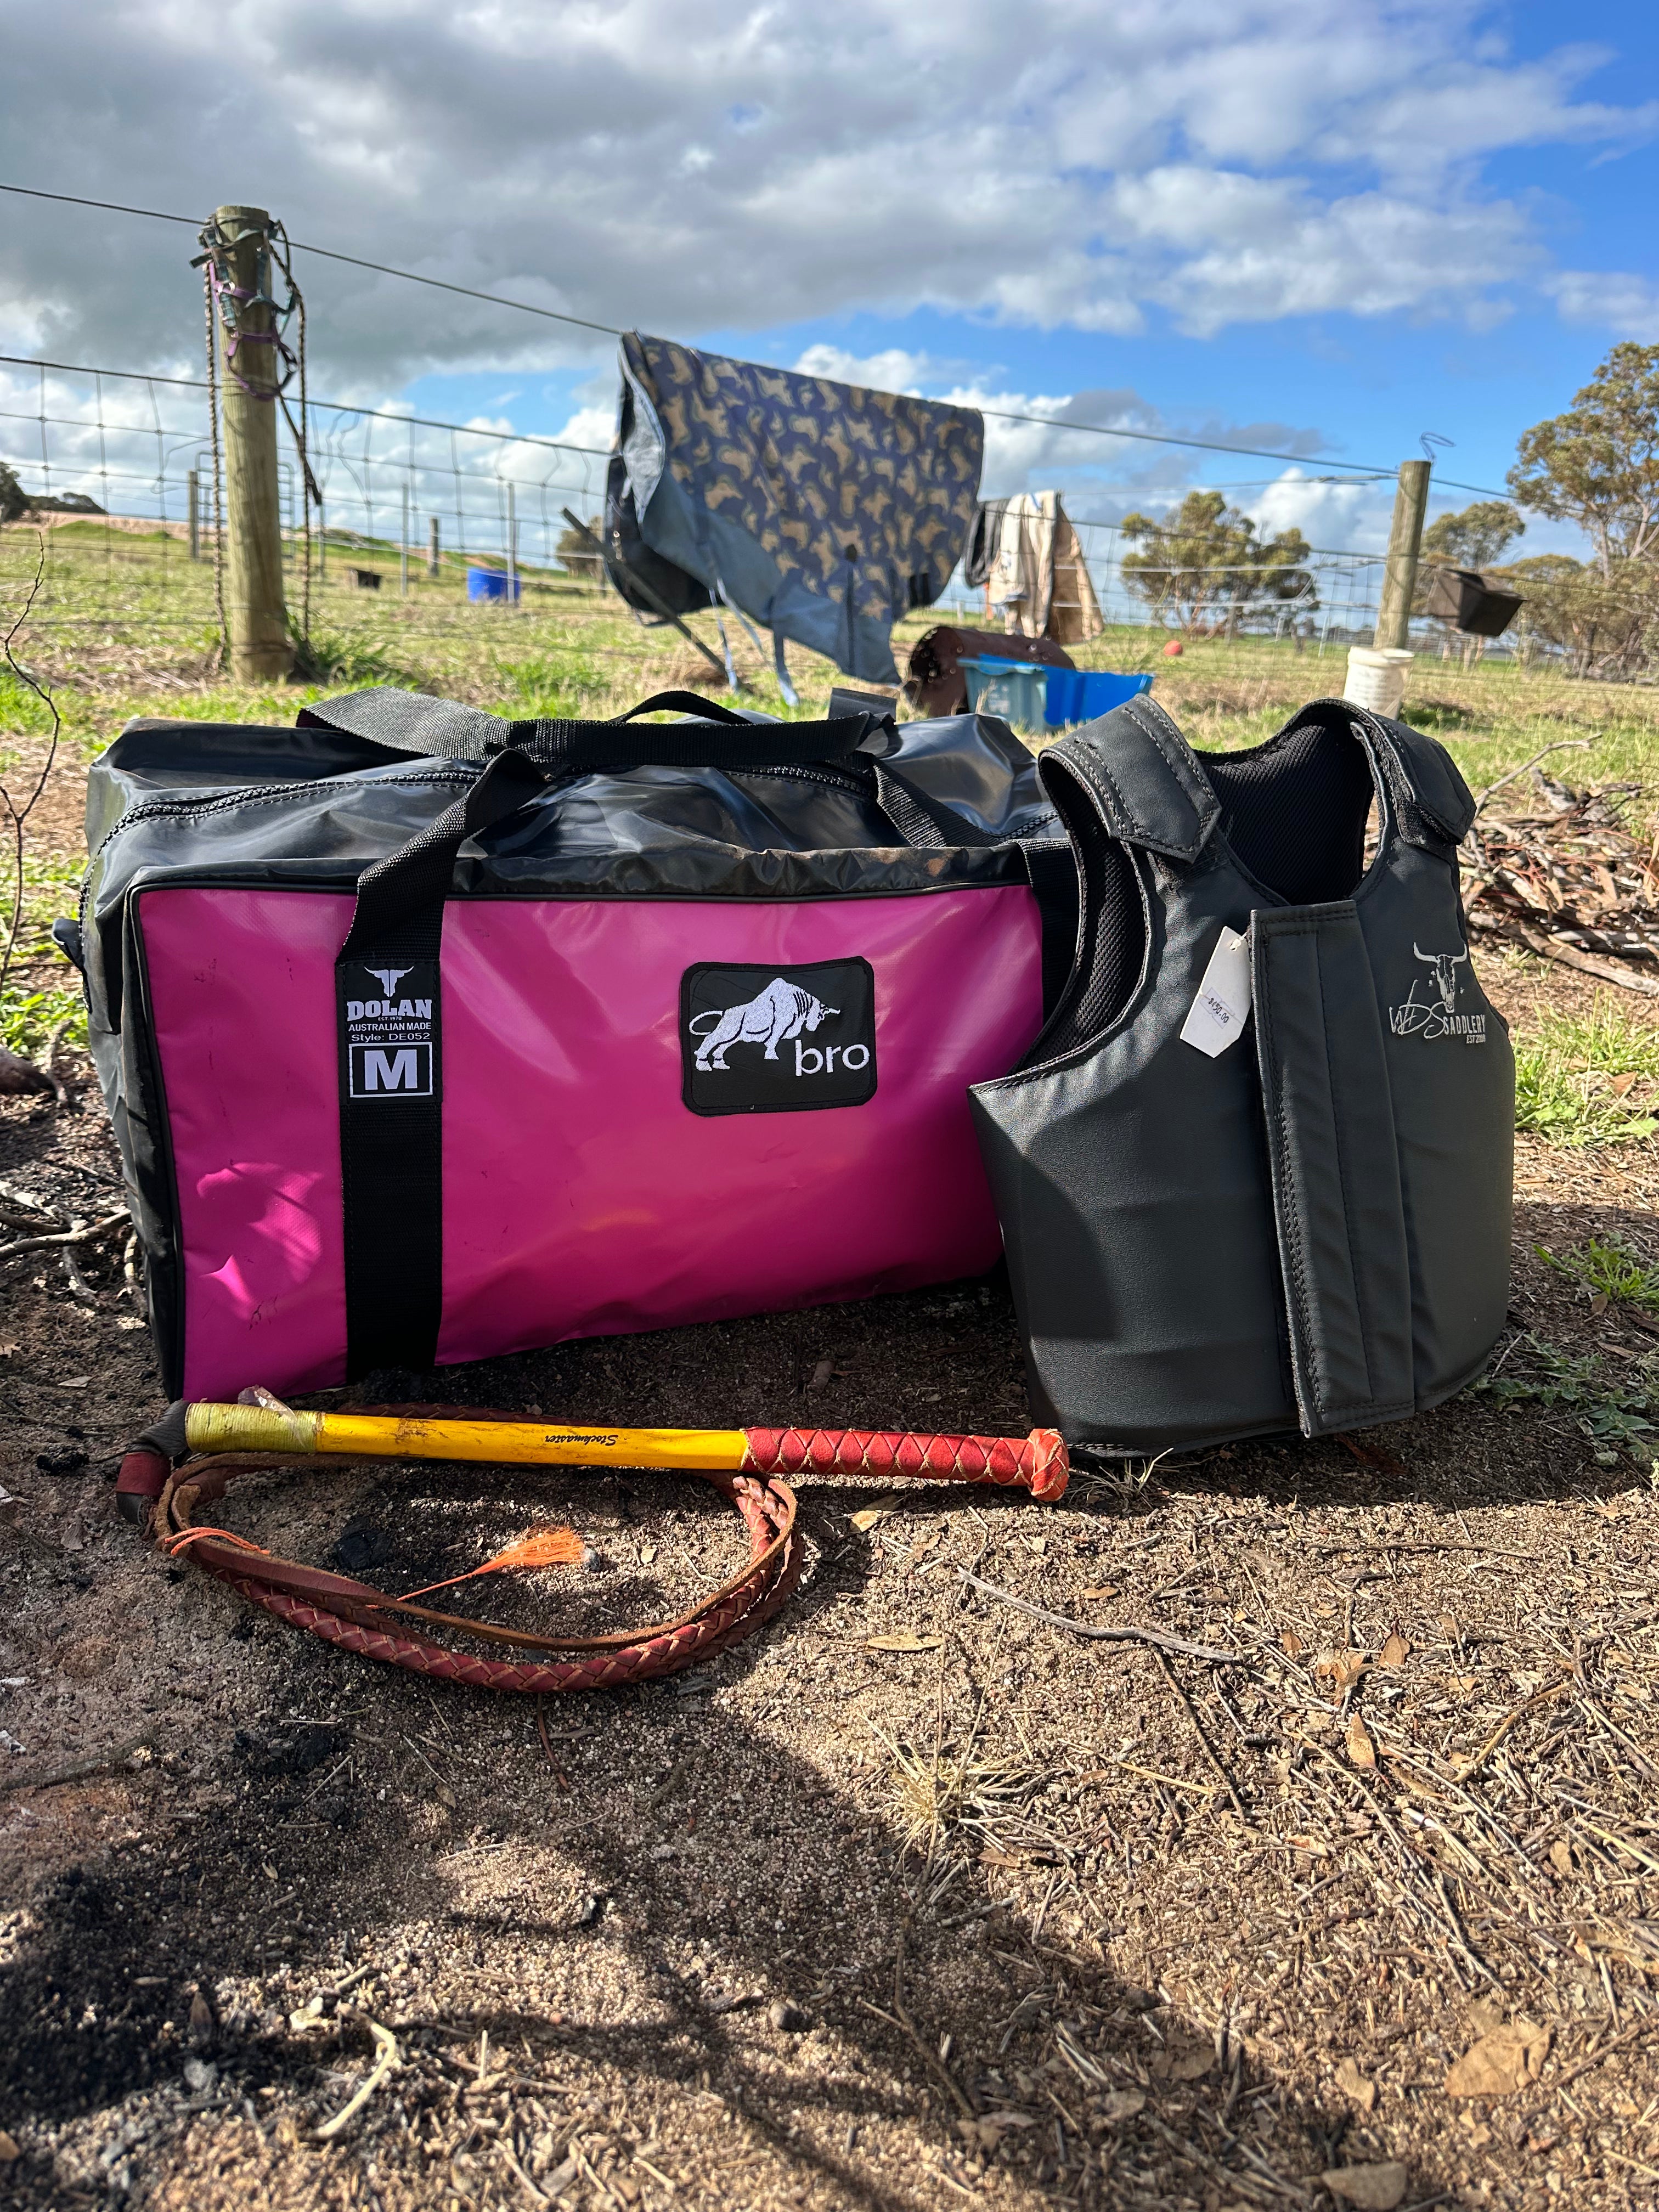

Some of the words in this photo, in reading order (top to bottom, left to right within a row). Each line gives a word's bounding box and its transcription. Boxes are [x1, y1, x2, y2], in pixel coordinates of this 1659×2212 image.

[347, 999, 432, 1022] DOLAN
[1208, 997, 1229, 1023] $450.00
[348, 1023, 405, 1031] AUSTRALIAN
[407, 1022, 432, 1030] MADE
[1443, 1014, 1485, 1035] SADDLERY
[351, 1034, 385, 1043] Style:
[389, 1032, 430, 1041] DE052
[795, 1040, 870, 1076] bro
[364, 1049, 418, 1091] M
[545, 1435, 619, 1447] Stockmaster
